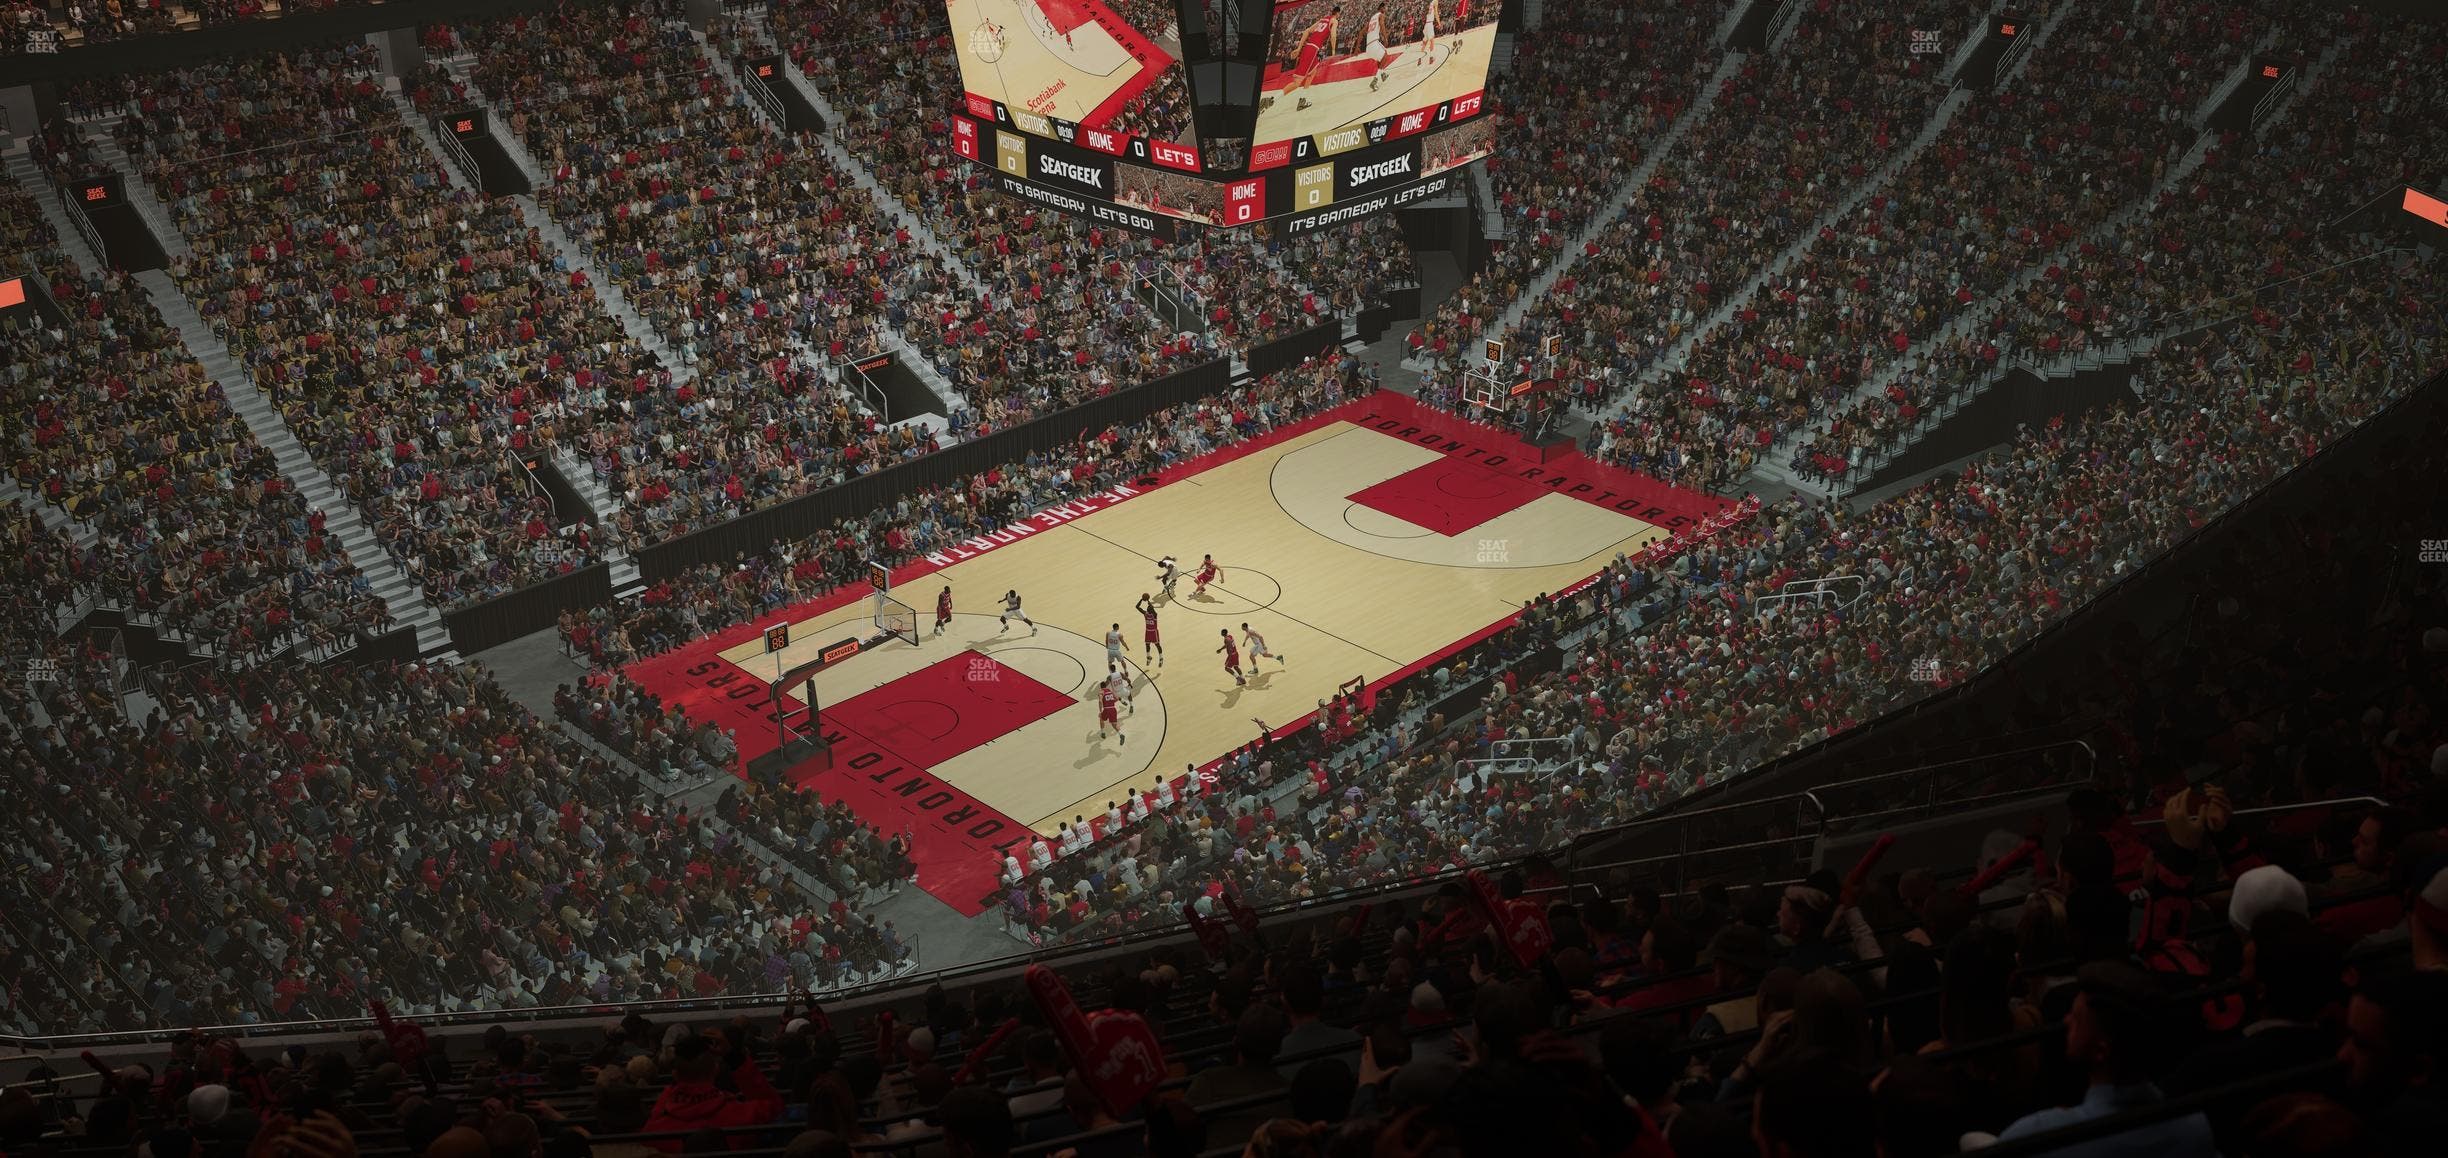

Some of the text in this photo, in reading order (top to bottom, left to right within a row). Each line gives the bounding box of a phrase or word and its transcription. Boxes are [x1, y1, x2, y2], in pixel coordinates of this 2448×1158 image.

[1026, 78, 1067, 112] Scotiabank
[996, 106, 1005, 121] 0
[1038, 100, 1057, 116] rena
[1439, 105, 1448, 121] 0
[1454, 96, 1480, 115] LET'S
[957, 120, 972, 137] HOME
[1015, 111, 1050, 136] VISITORS
[1400, 111, 1424, 134] HOME
[962, 140, 970, 155] 0
[998, 135, 1024, 154] VISITORS
[1088, 130, 1115, 151] HOME
[1134, 141, 1144, 157] 0
[1296, 140, 1308, 157] 0
[1323, 128, 1362, 153] VISITORS
[1007, 155, 1016, 171] 0
[1156, 147, 1194, 166] LET'S
[1040, 154, 1102, 189] SEATGEEK
[1298, 166, 1331, 187] VISITORS
[1350, 152, 1411, 187] SEATGEEK
[1232, 182, 1257, 201] HOME
[1309, 189, 1320, 205] 0
[1003, 178, 1154, 231] IT'S GAMEDAY LET'S GO!
[1238, 204, 1250, 220] 0
[1289, 178, 1446, 233] IT'S GAMEDAY LET'S GO!
[1358, 413, 1690, 527] TORONTO RAPTORS
[772, 636, 785, 650] 88
[848, 751, 1027, 853] TORONTO
